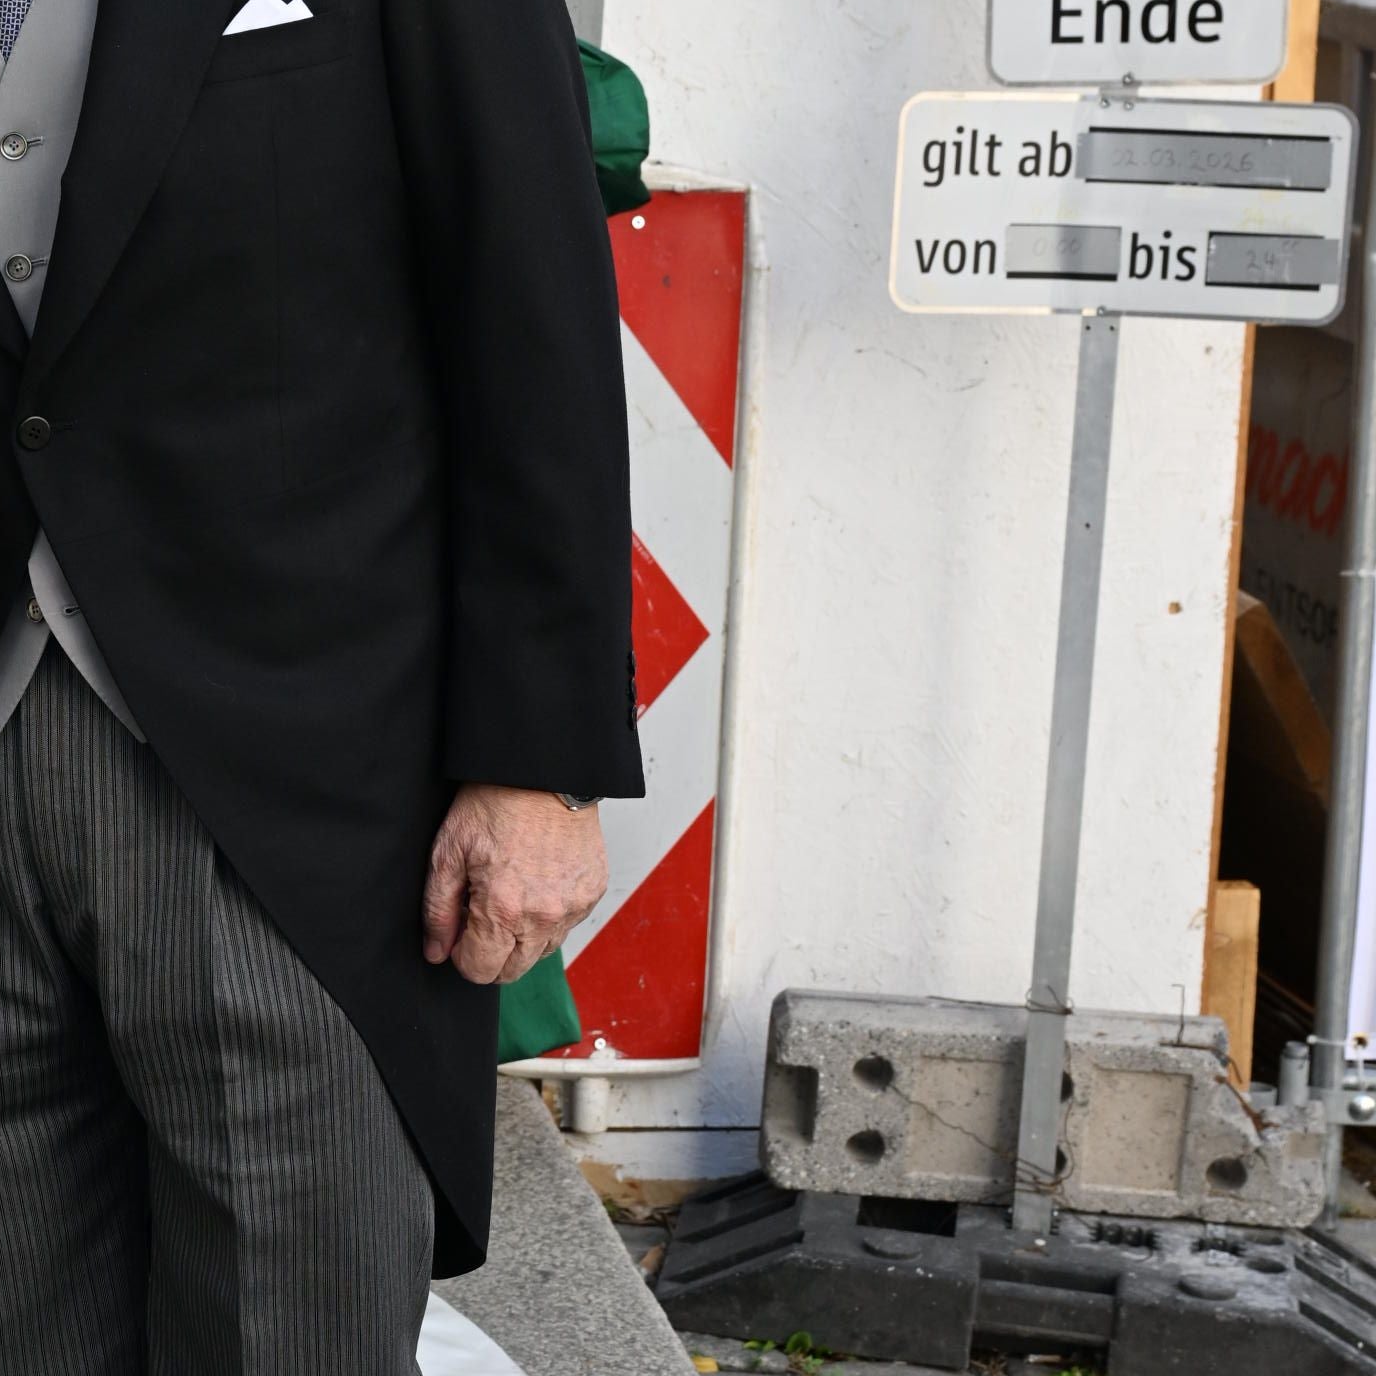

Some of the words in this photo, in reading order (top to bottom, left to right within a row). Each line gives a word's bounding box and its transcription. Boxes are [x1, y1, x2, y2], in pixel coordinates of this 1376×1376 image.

[922, 126, 1002, 187] gilt
[1018, 131, 1073, 178] ab
[915, 237, 996, 275] von
[1129, 230, 1197, 281] bis
